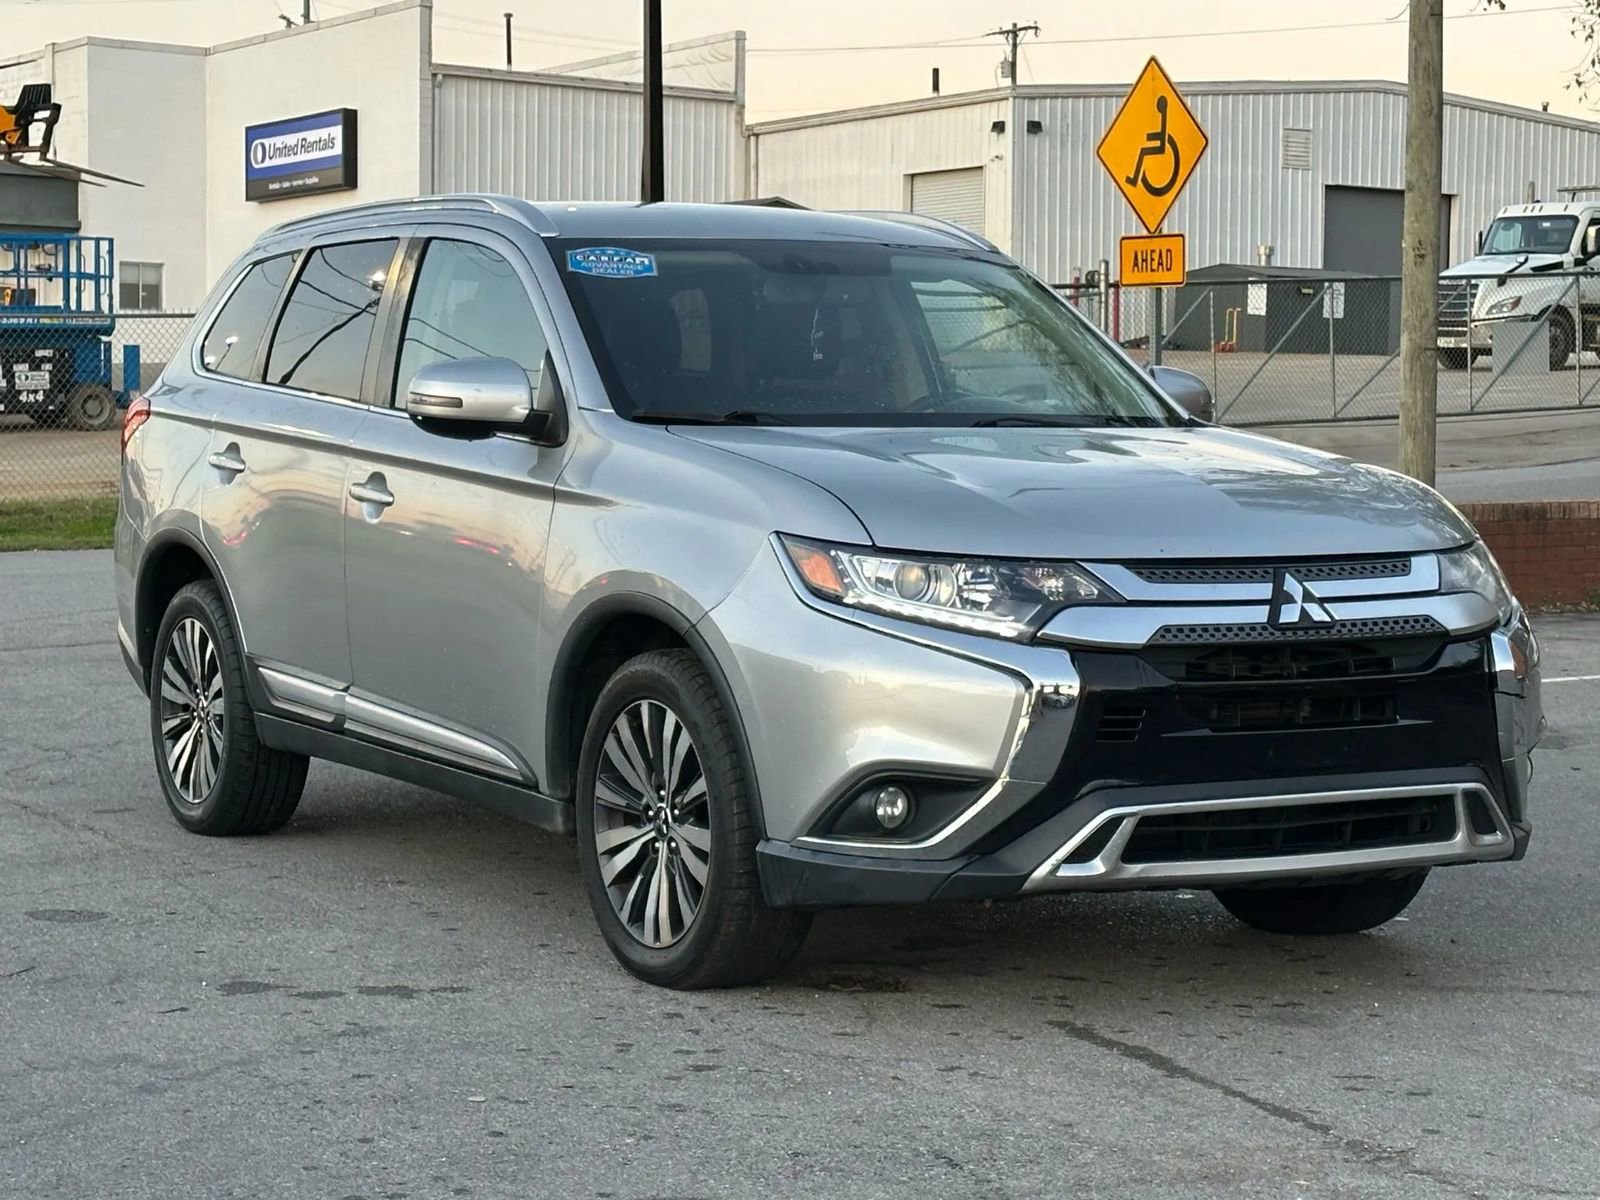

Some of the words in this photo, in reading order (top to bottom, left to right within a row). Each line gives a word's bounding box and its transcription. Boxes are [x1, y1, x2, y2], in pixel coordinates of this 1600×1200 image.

[268, 138, 299, 160] United
[300, 133, 336, 155] Rentals
[1132, 248, 1173, 273] AHEAD
[592, 267, 634, 275] DEALER
[19, 390, 45, 403] 4x4
